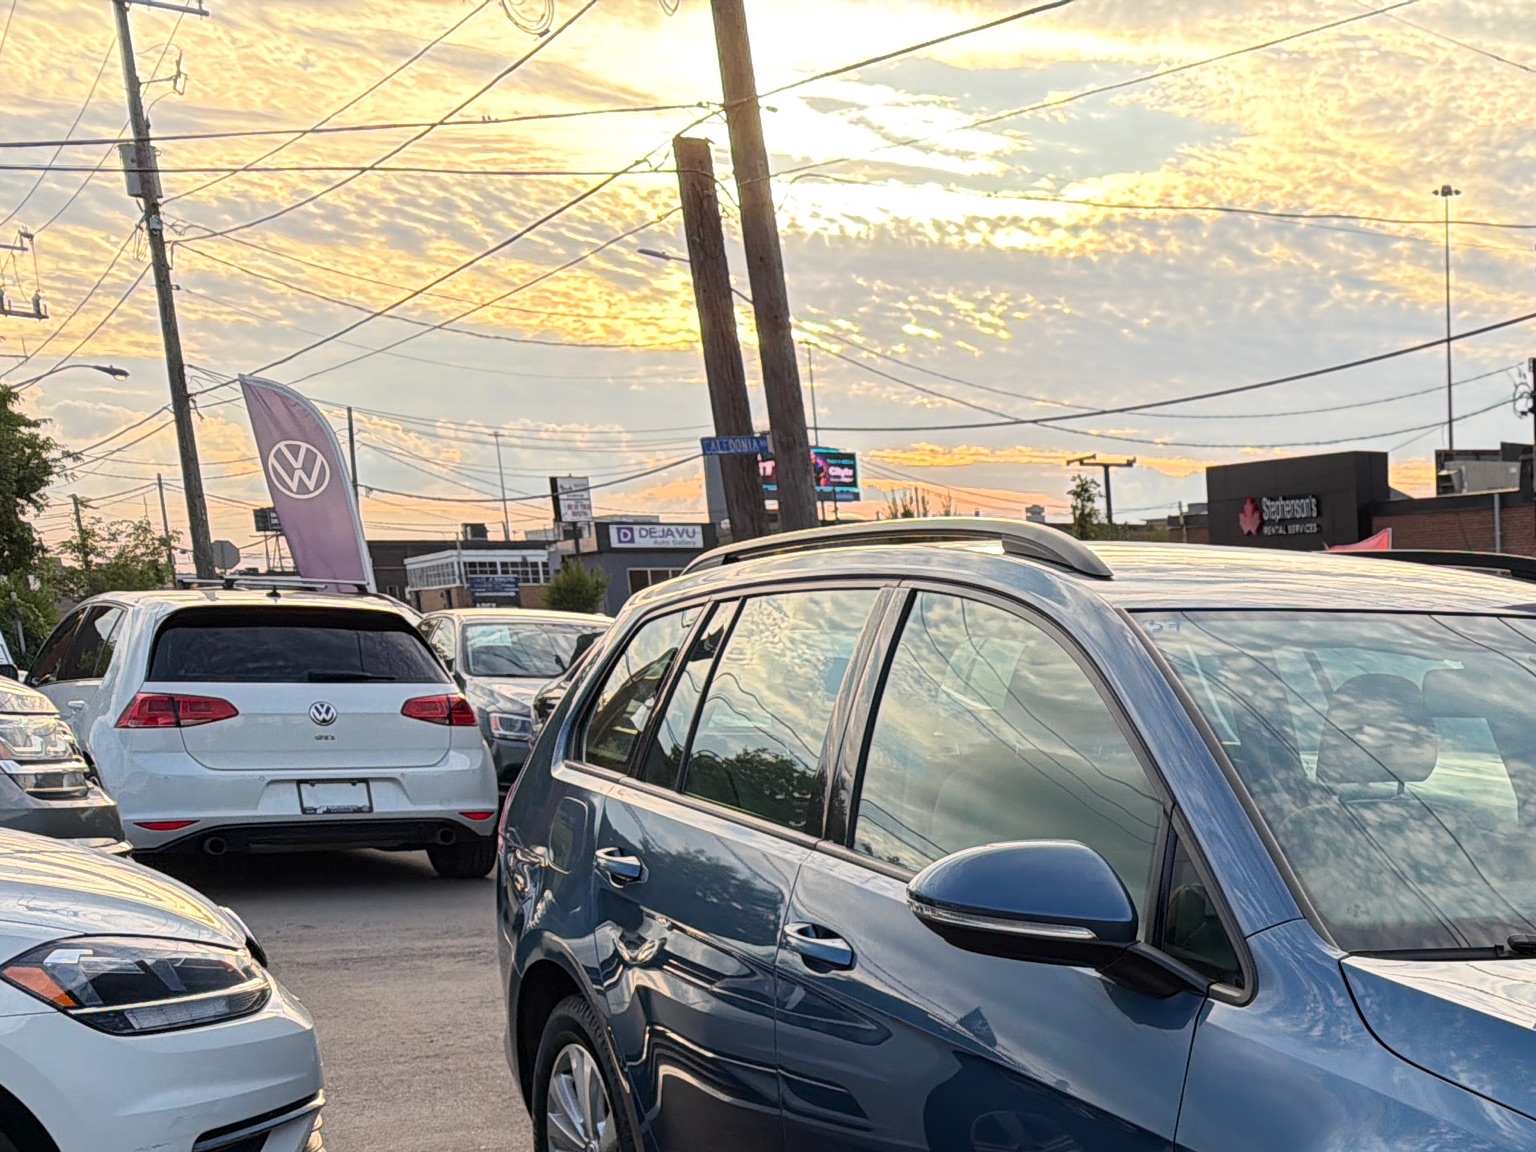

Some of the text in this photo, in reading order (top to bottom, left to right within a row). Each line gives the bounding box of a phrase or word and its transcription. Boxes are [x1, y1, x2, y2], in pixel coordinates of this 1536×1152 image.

[268, 440, 330, 499] VW
[1262, 495, 1317, 523] Stephenson's
[1263, 523, 1318, 536] RENTAL SERVICES
[309, 701, 338, 726] VW
